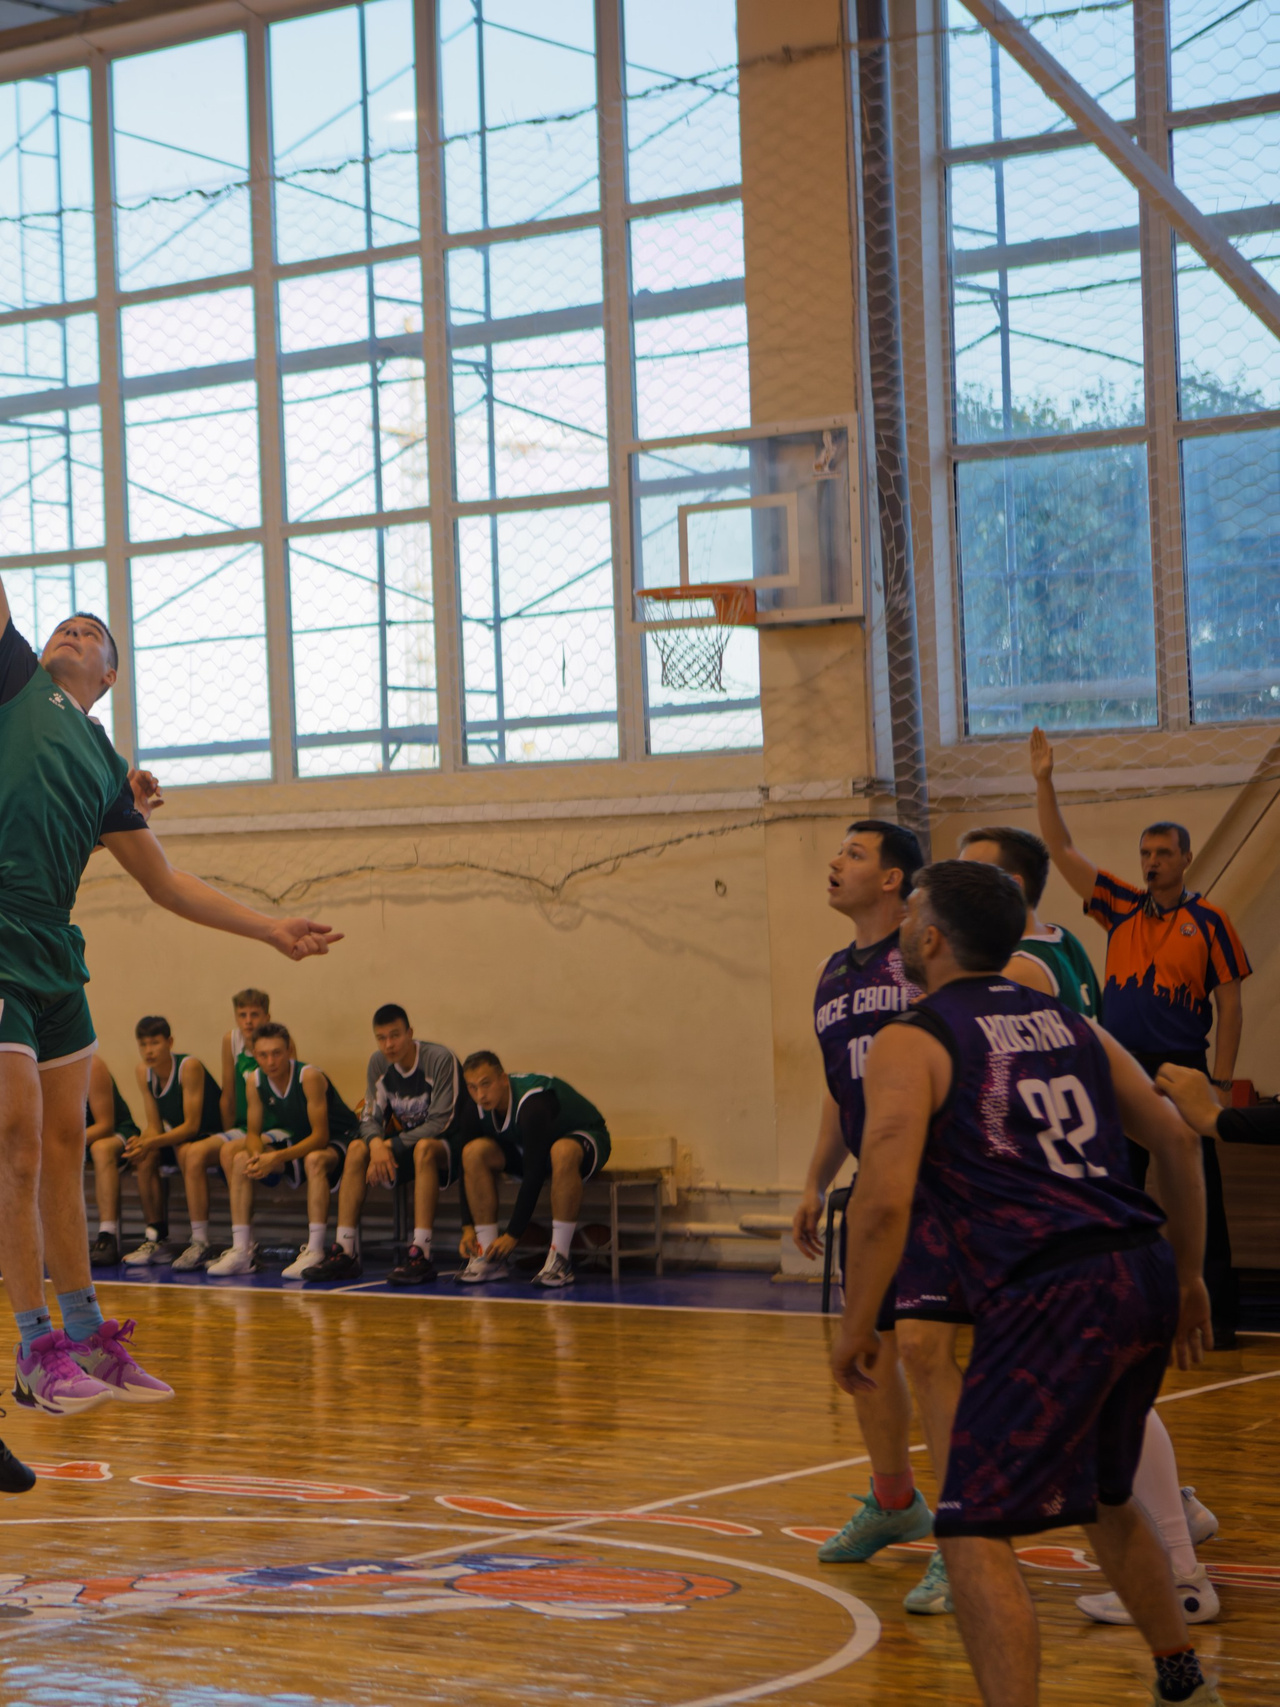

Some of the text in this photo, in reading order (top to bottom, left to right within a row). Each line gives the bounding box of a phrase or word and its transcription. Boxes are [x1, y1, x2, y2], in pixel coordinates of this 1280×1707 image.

[816, 993, 850, 1034] ВСЕ
[974, 1009, 1077, 1053] КОСТЯН
[1016, 1074, 1109, 1179] 22
